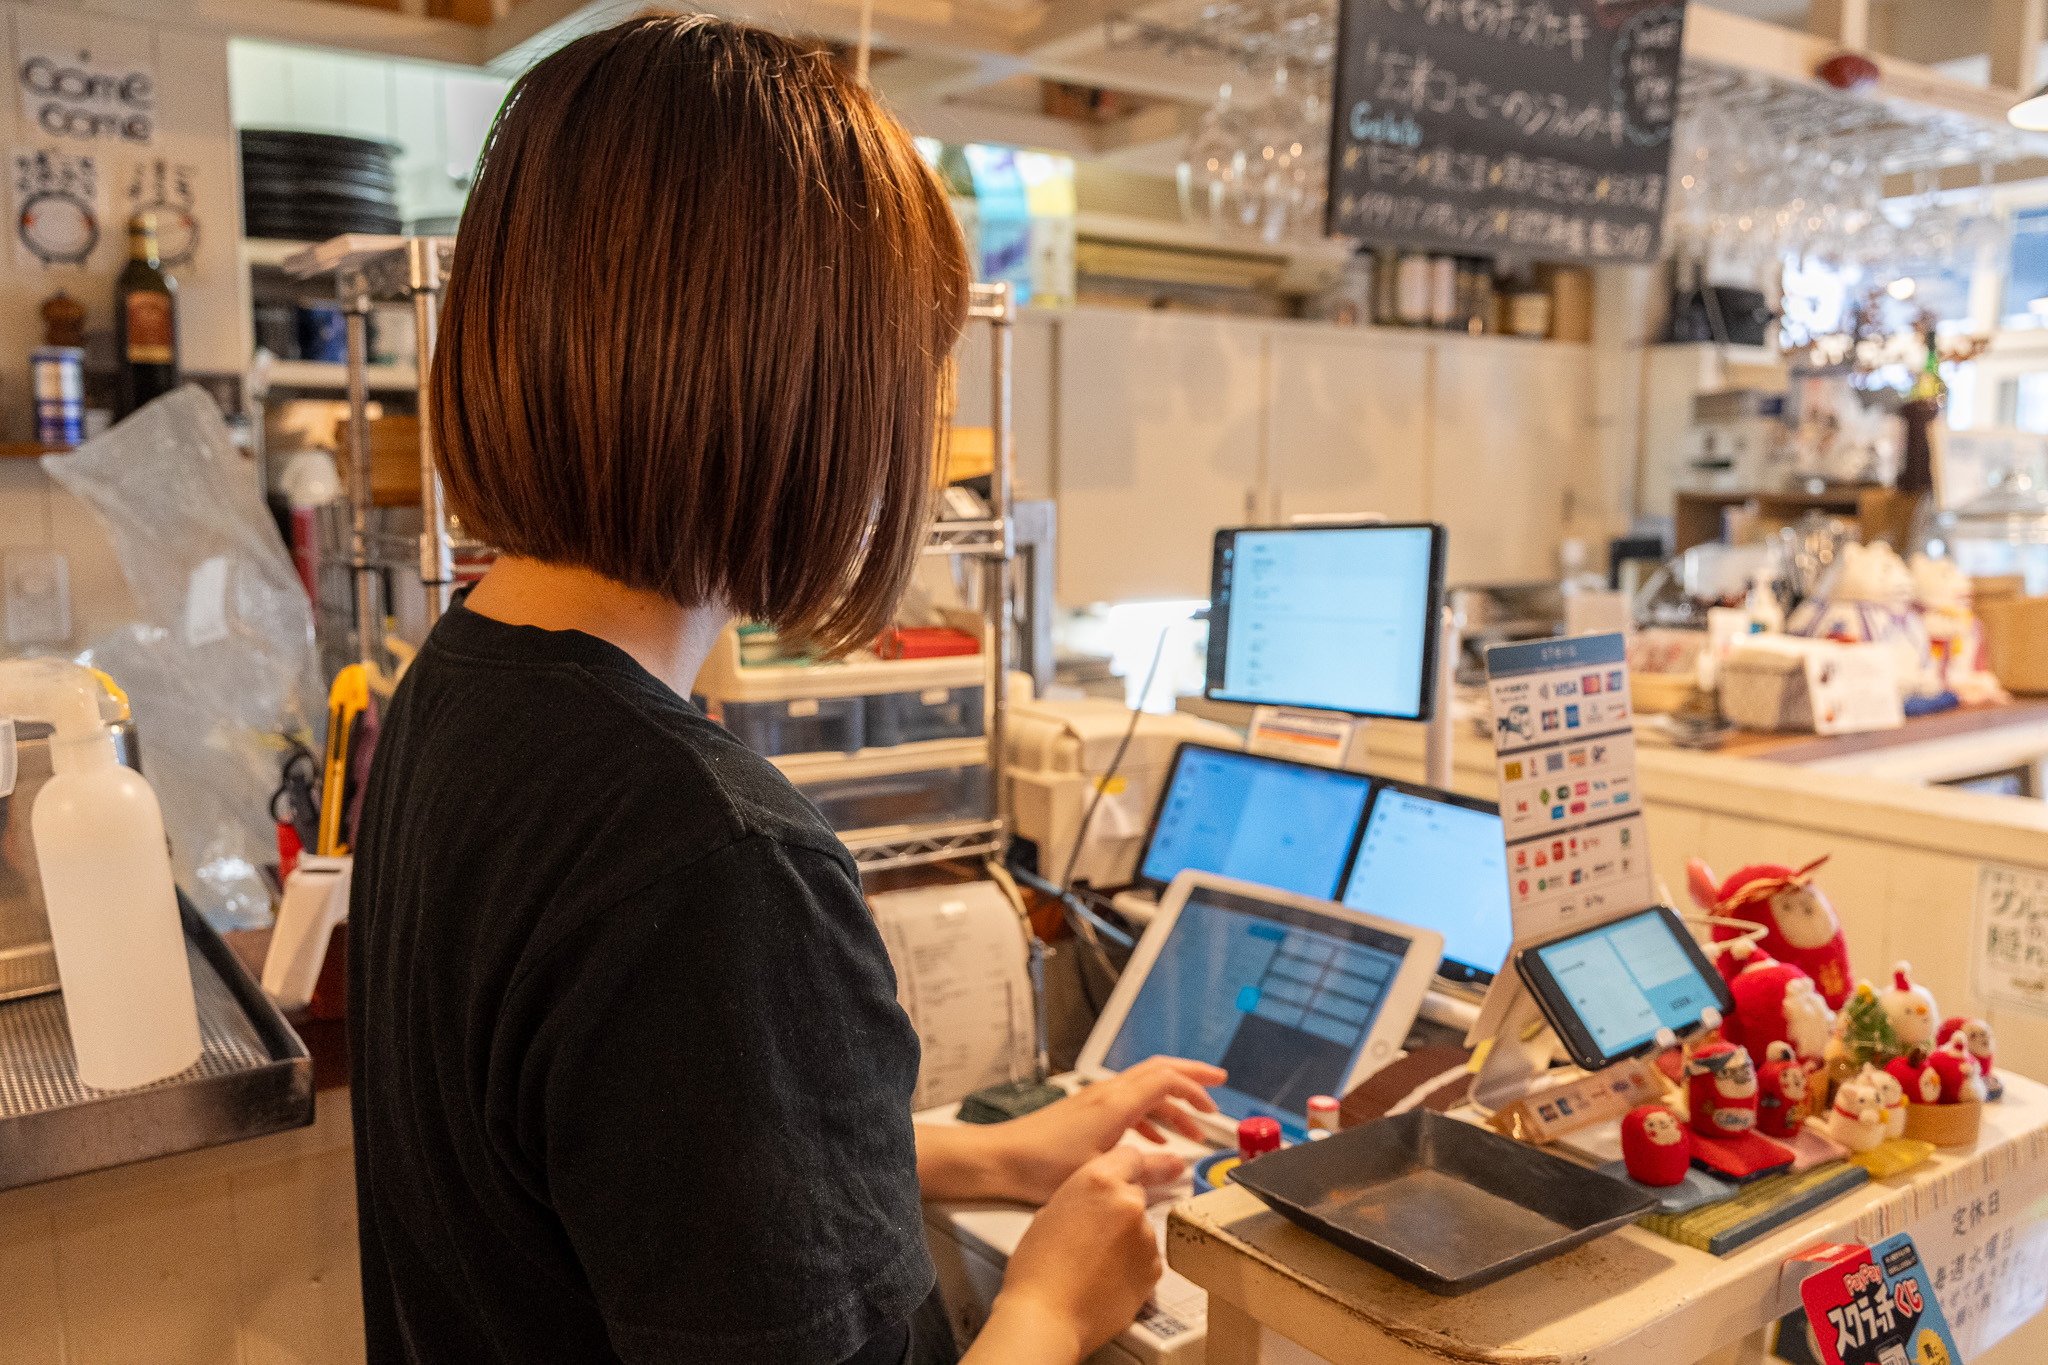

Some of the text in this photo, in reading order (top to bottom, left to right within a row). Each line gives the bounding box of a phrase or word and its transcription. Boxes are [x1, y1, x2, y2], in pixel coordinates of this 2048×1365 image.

[1951, 1189, 2000, 1236] 定休日
[1843, 1263, 1884, 1297] PayPay
[1934, 1227, 2015, 1290] 毎週火曜日
